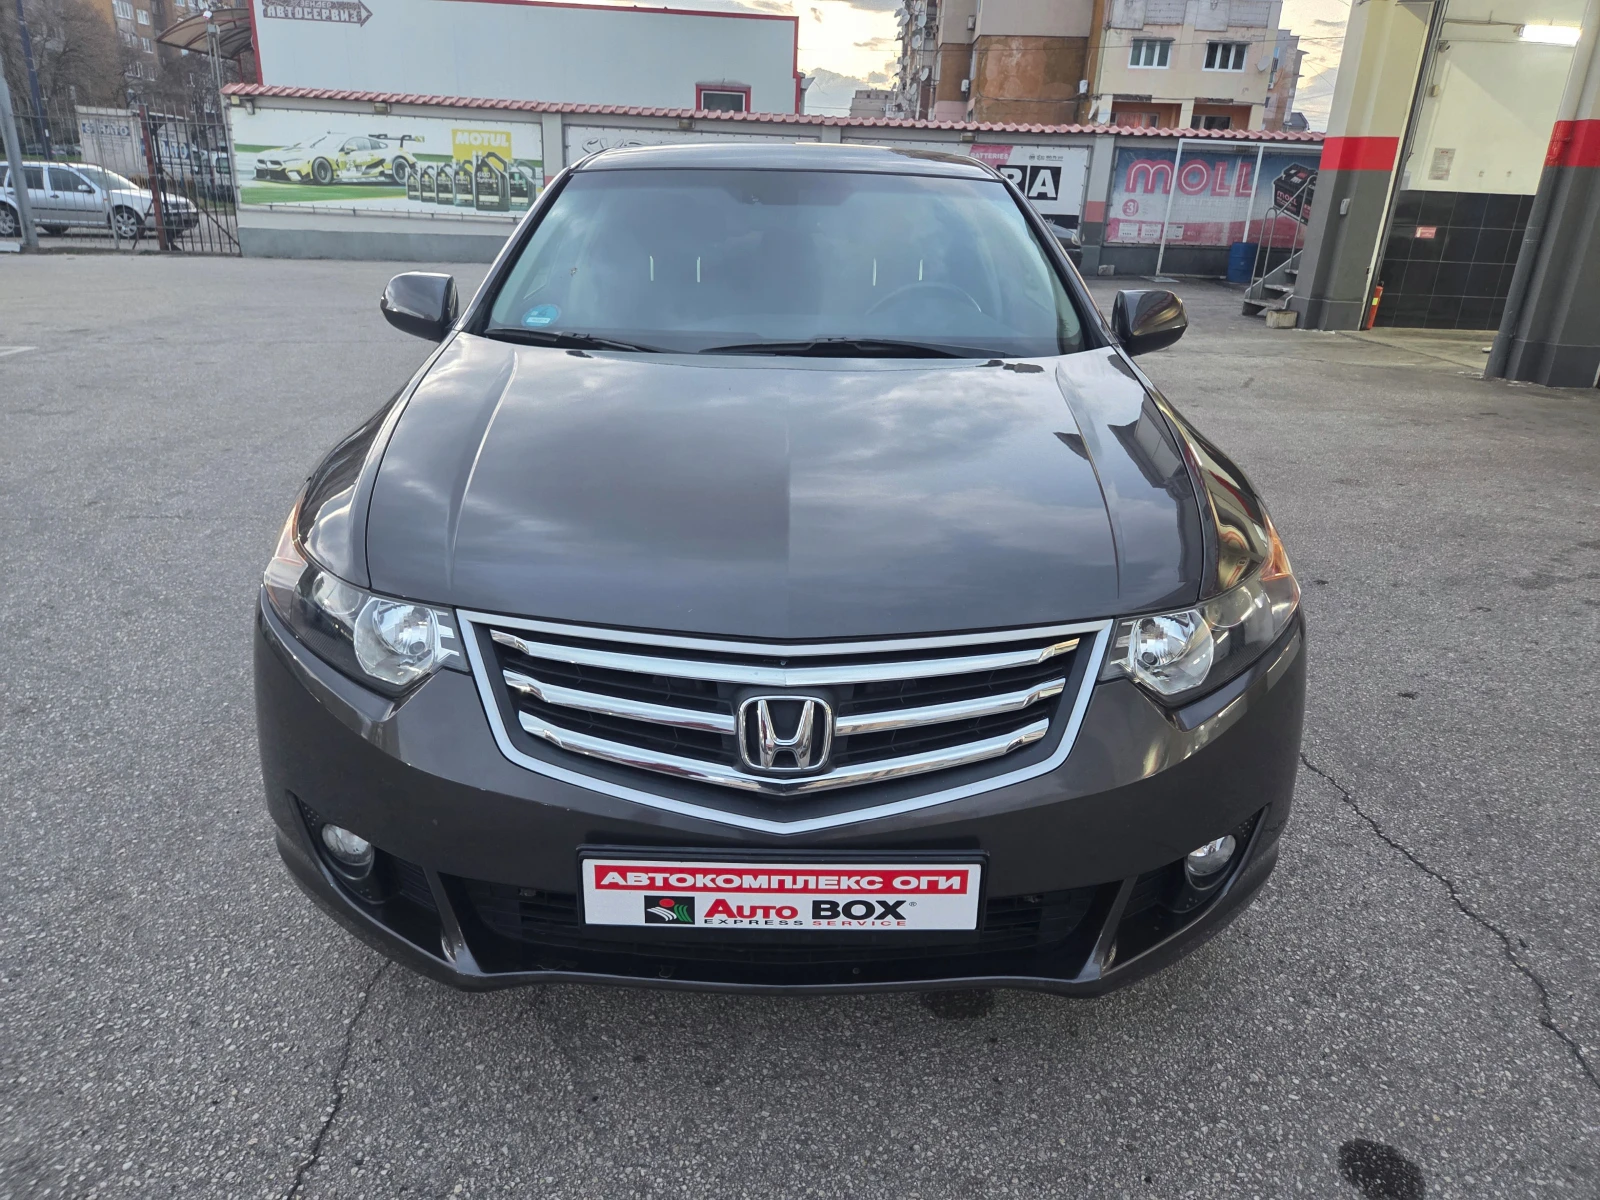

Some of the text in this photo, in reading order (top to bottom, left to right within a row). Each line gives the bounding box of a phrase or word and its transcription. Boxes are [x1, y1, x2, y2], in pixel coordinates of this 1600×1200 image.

[267, 5, 358, 22] АВТОСЕРВИЗ
[455, 131, 509, 147] MOTUL
[970, 152, 1009, 160] BATTERIES
[600, 871, 961, 890] АВТОКОМПЛЕКС ОГИ
[703, 918, 804, 926] EXPRESS
